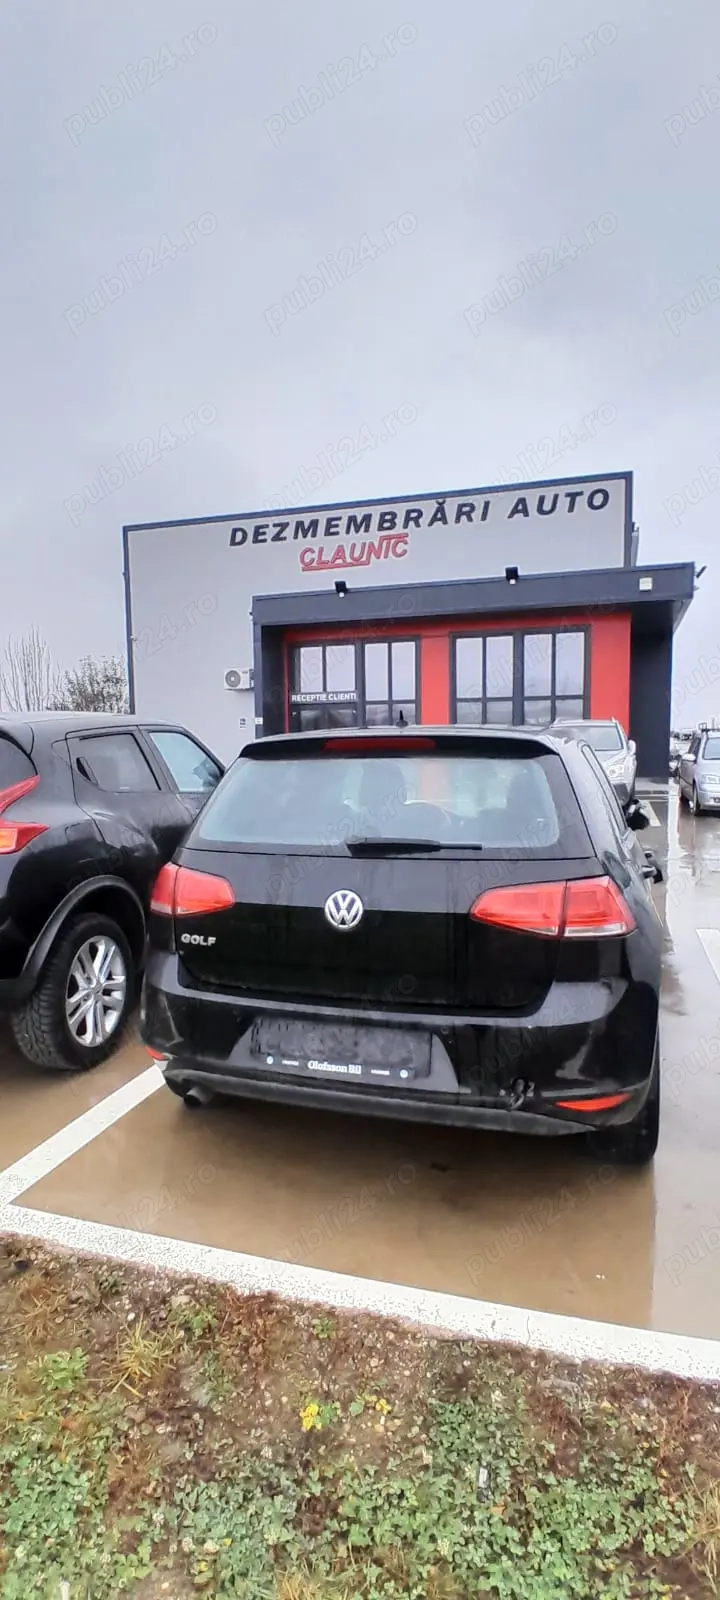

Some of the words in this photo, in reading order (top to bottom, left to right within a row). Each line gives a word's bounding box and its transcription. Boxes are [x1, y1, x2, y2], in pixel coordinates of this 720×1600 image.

[229, 499, 490, 546] DEZMEMBRĂRI
[507, 488, 610, 519] AUTO
[300, 533, 408, 571] CLAUNIC
[181, 933, 217, 947] GOLF
[307, 1060, 348, 1073] Olofsson
